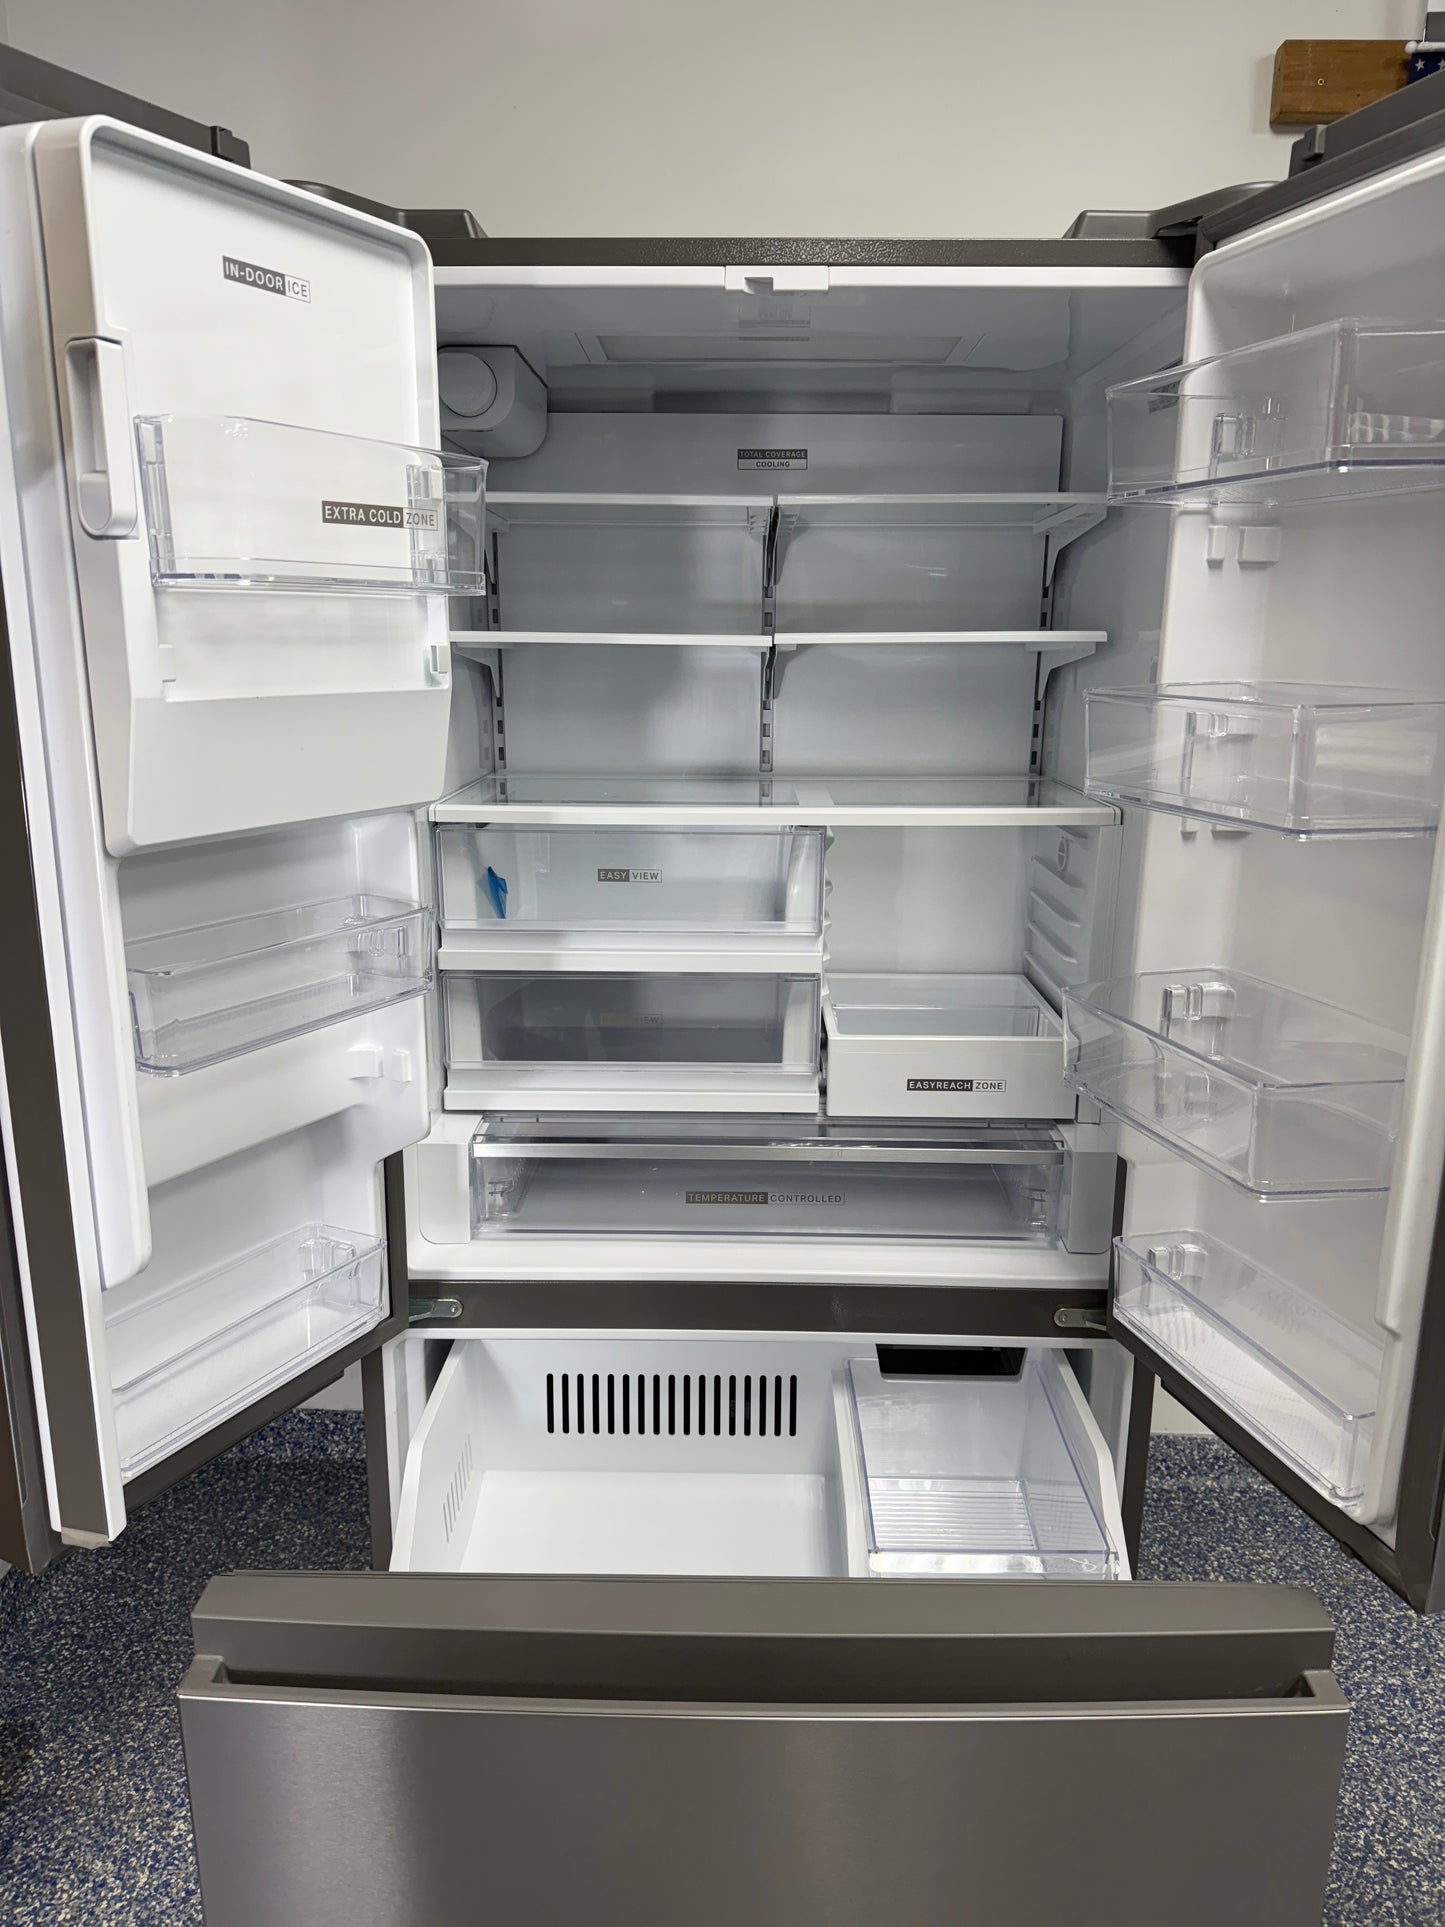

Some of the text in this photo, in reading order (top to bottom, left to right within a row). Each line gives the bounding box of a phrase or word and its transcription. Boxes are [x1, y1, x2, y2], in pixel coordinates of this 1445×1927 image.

[224, 260, 309, 298] IN-DOOR ICE
[739, 450, 806, 458] TOTAL COVERAGE
[755, 460, 791, 468] COOLING
[324, 505, 436, 527] EXTRA COLD ZONE
[600, 871, 659, 880] EASY VIEW
[908, 1081, 1004, 1090] EASYREACH ZONE
[687, 1193, 843, 1203] TEMPERATURE CONTROLLED
